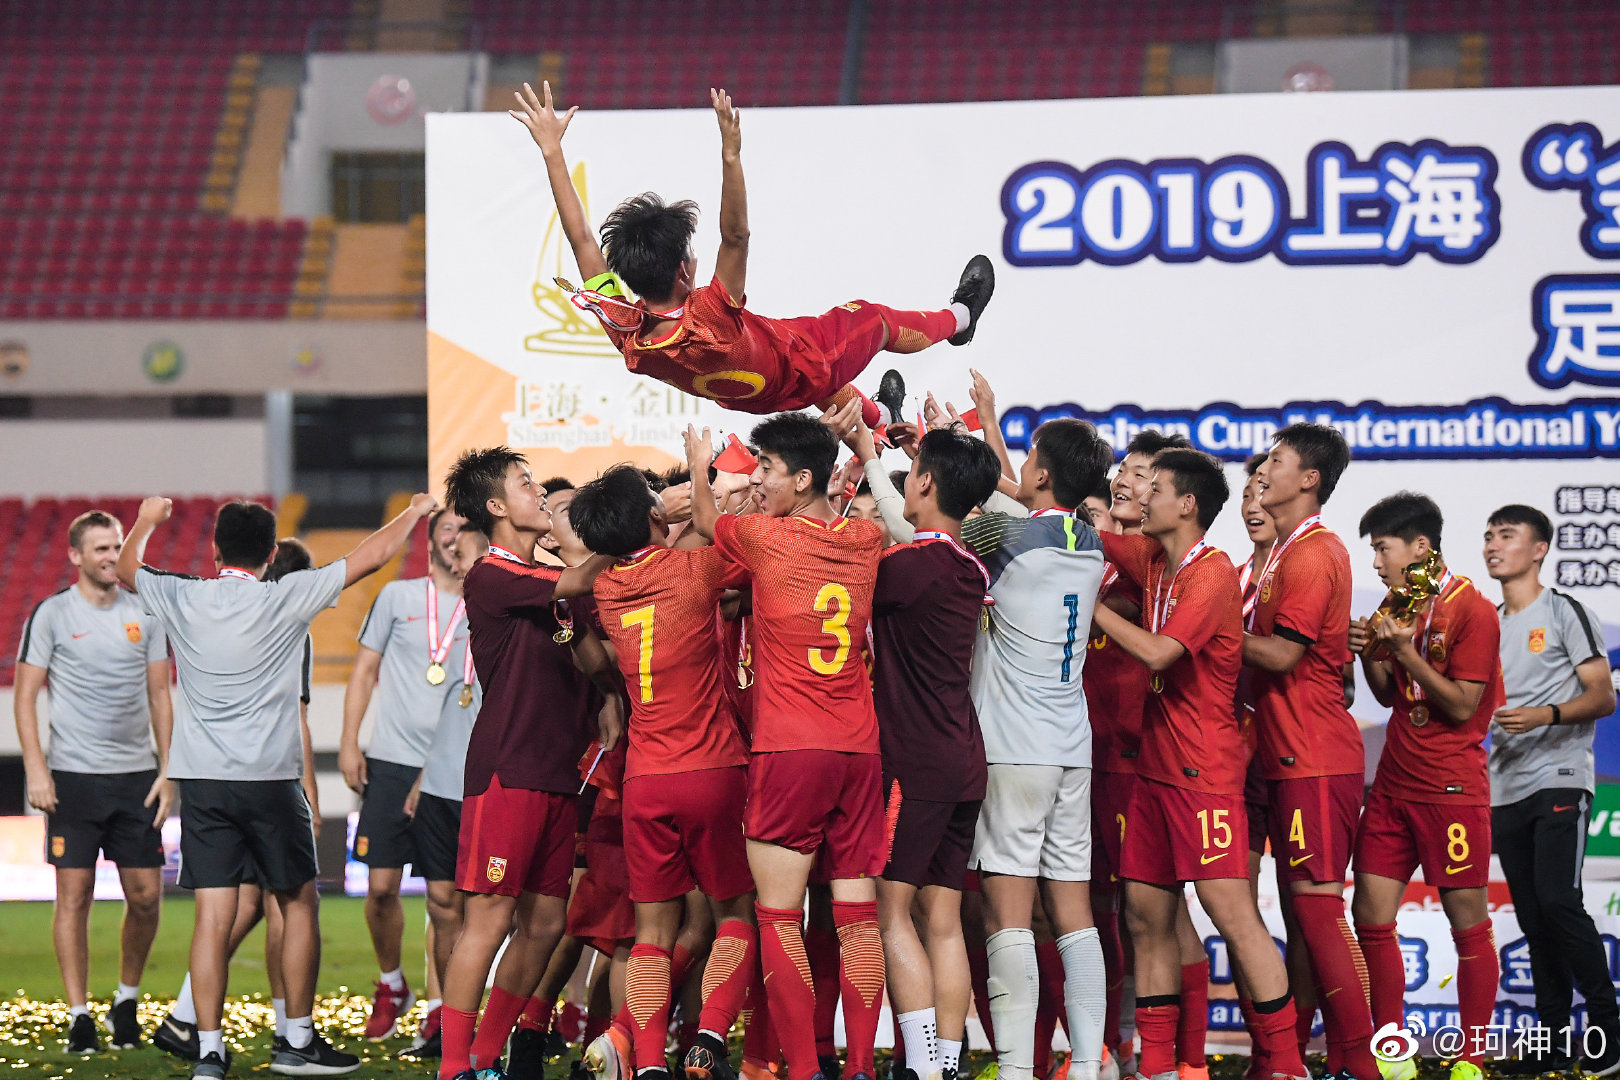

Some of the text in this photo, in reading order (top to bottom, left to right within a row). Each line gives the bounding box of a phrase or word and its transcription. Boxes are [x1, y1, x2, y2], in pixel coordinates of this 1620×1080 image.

[1014, 151, 1484, 252] 2019上海
[620, 605, 656, 704] 7
[807, 582, 852, 675] 3
[1062, 594, 1079, 682] 1
[1196, 808, 1233, 850] 15
[1288, 808, 1306, 850] 4
[1446, 822, 1470, 862] 8
